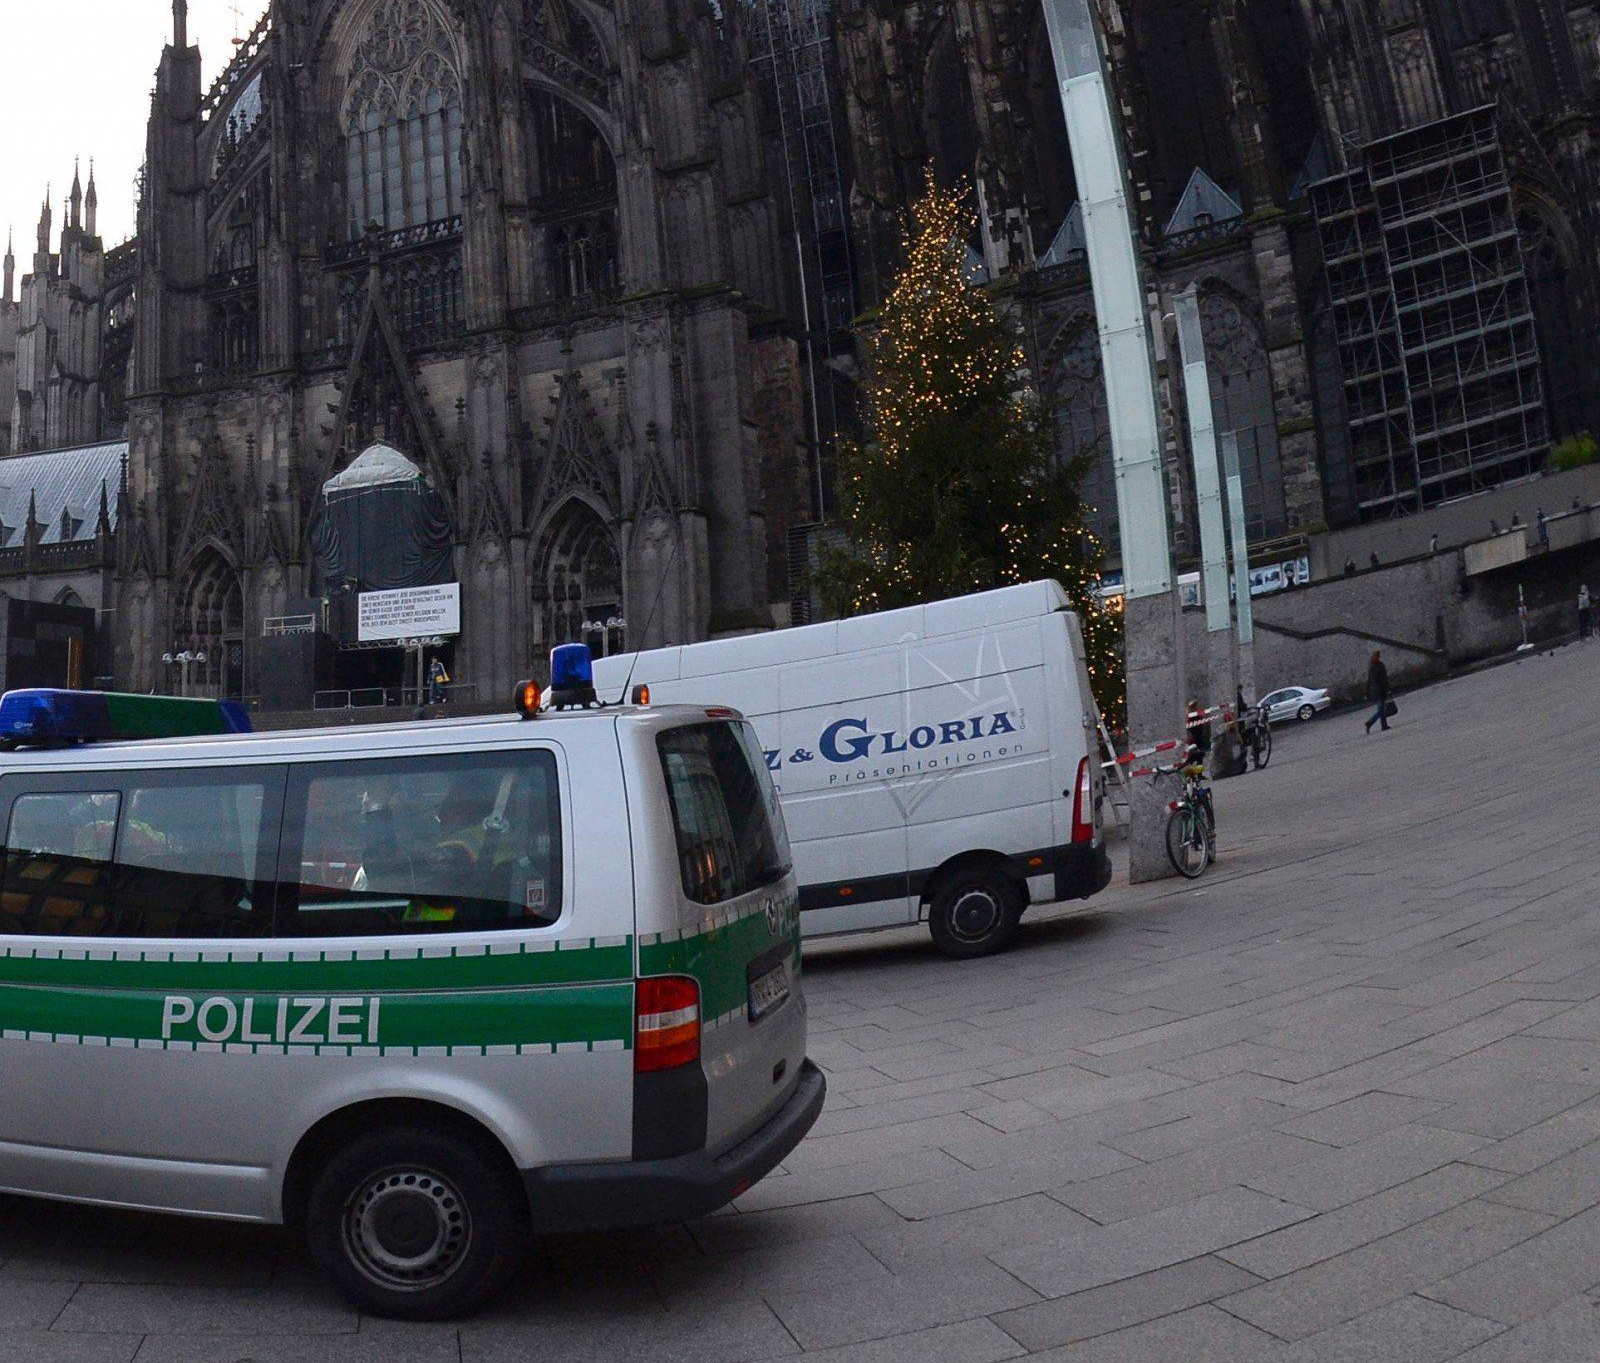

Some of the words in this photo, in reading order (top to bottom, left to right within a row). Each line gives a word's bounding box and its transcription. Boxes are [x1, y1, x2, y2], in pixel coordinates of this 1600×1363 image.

[788, 747, 814, 763] &
[829, 743, 1023, 785] Präsentationen
[162, 995, 380, 1043] POLIZEI
